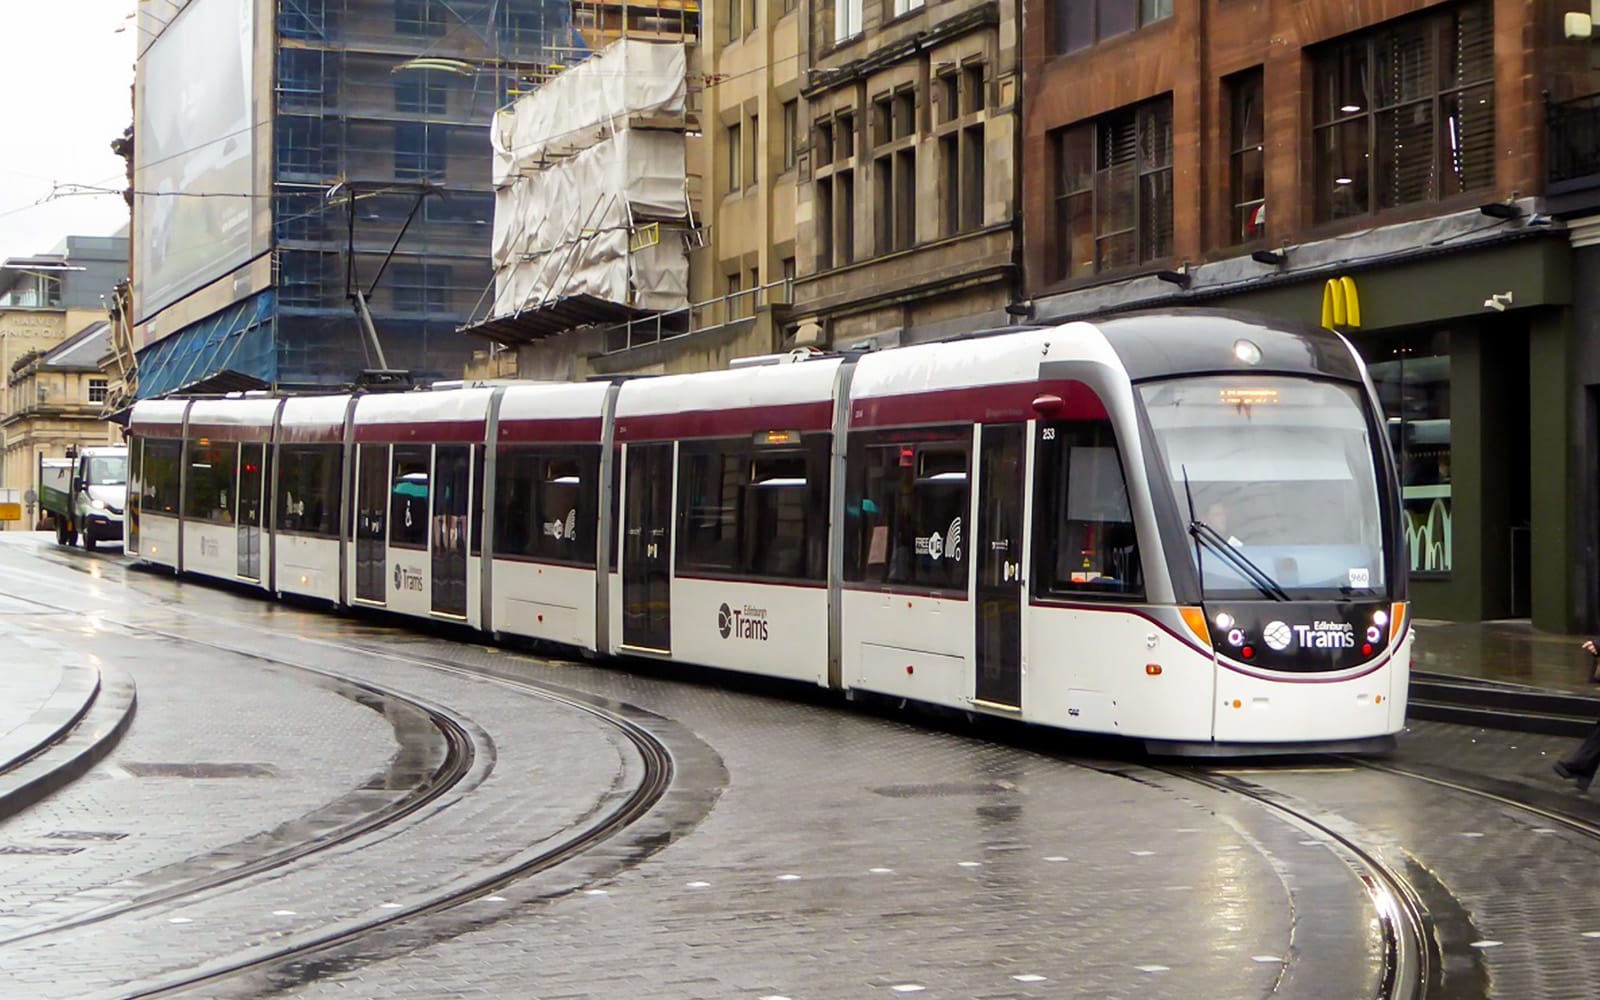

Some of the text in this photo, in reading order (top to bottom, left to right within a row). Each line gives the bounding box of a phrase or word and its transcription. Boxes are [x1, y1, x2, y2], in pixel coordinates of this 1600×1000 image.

[1042, 427, 1056, 440] 253
[733, 609, 768, 641] Trams
[1313, 620, 1353, 632] Edinburgh
[1293, 625, 1356, 648] Trams
